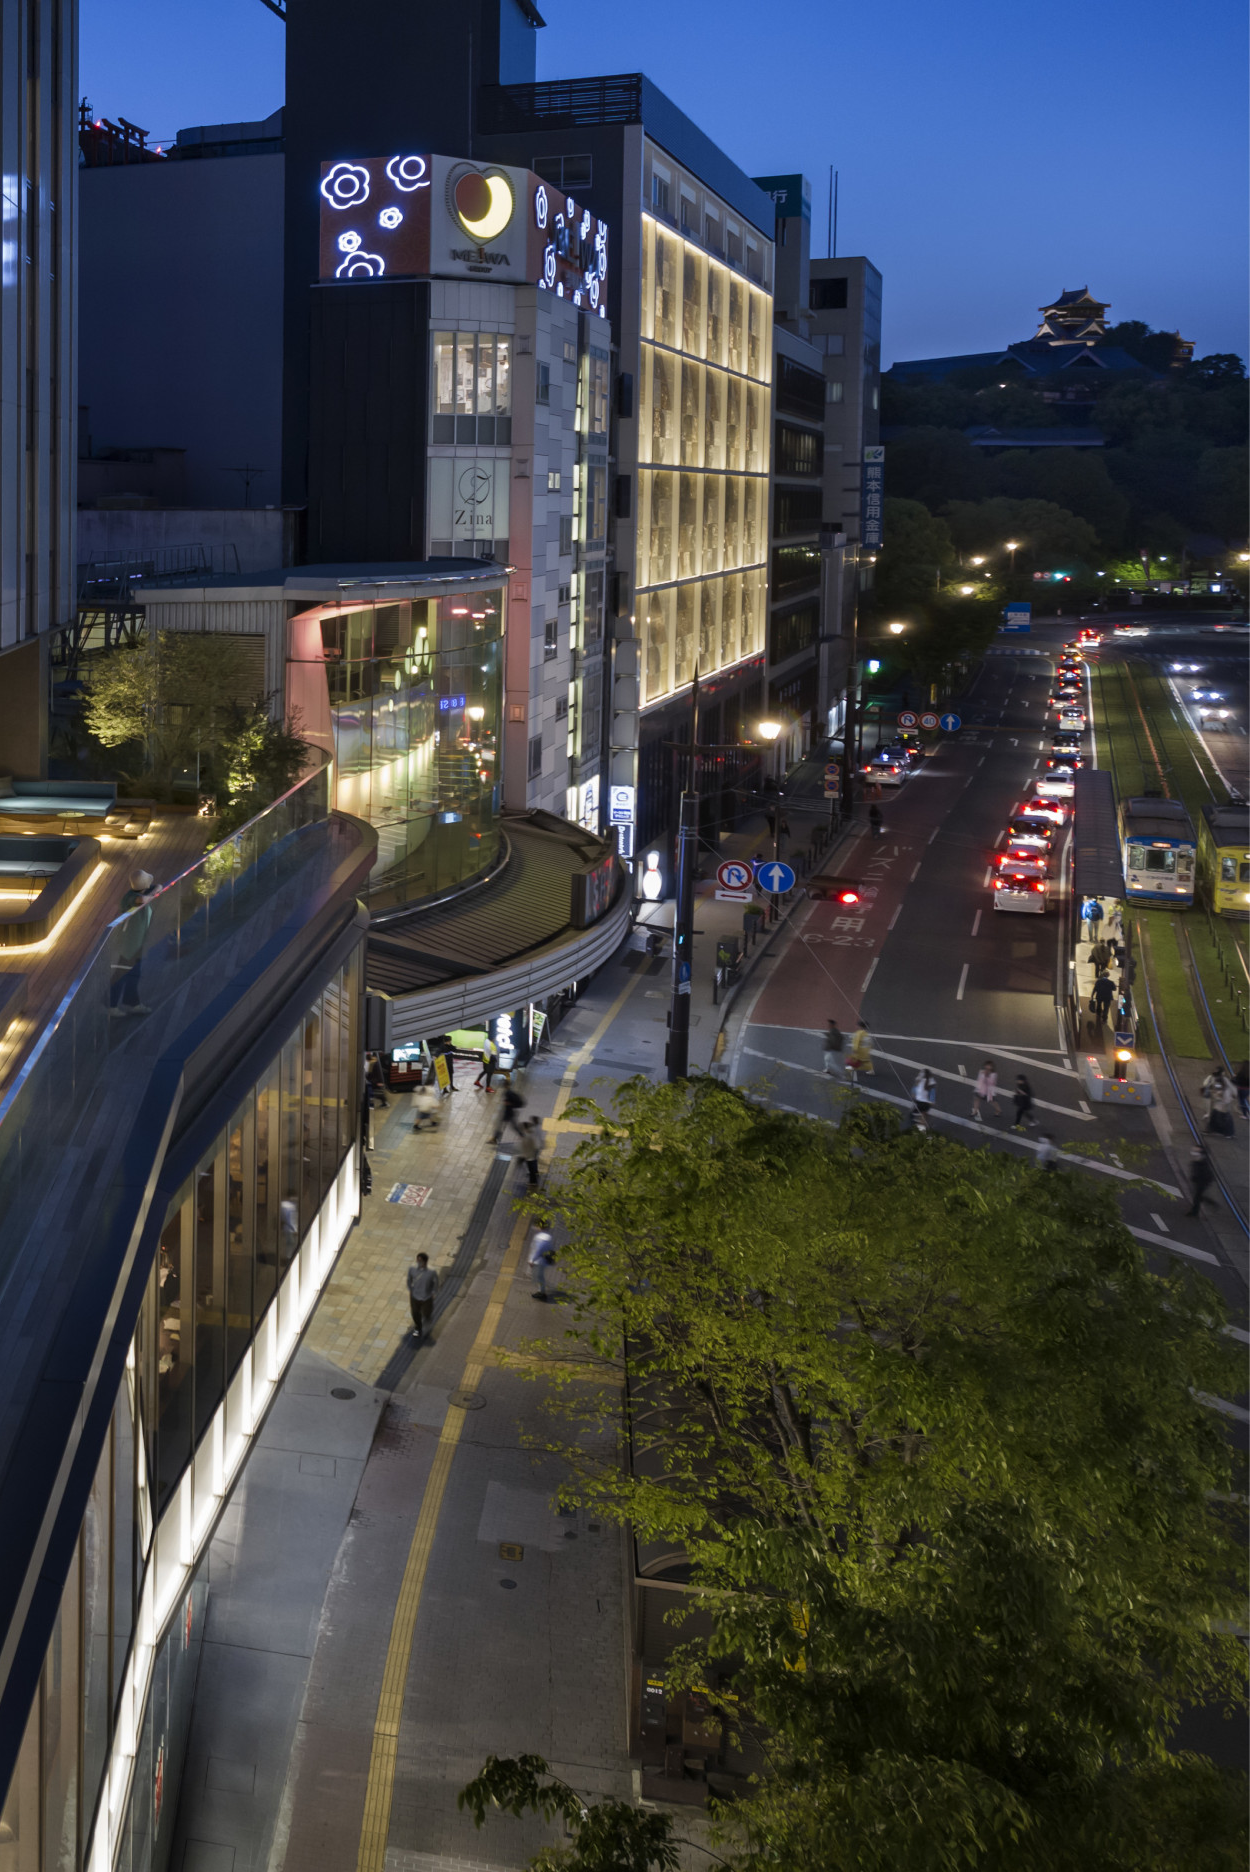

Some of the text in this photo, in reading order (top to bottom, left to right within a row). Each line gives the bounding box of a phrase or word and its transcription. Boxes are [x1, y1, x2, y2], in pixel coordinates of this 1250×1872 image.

[865, 466, 881, 544] 熊本信用金庫
[454, 509, 493, 525] Zina
[923, 717, 935, 726] 40
